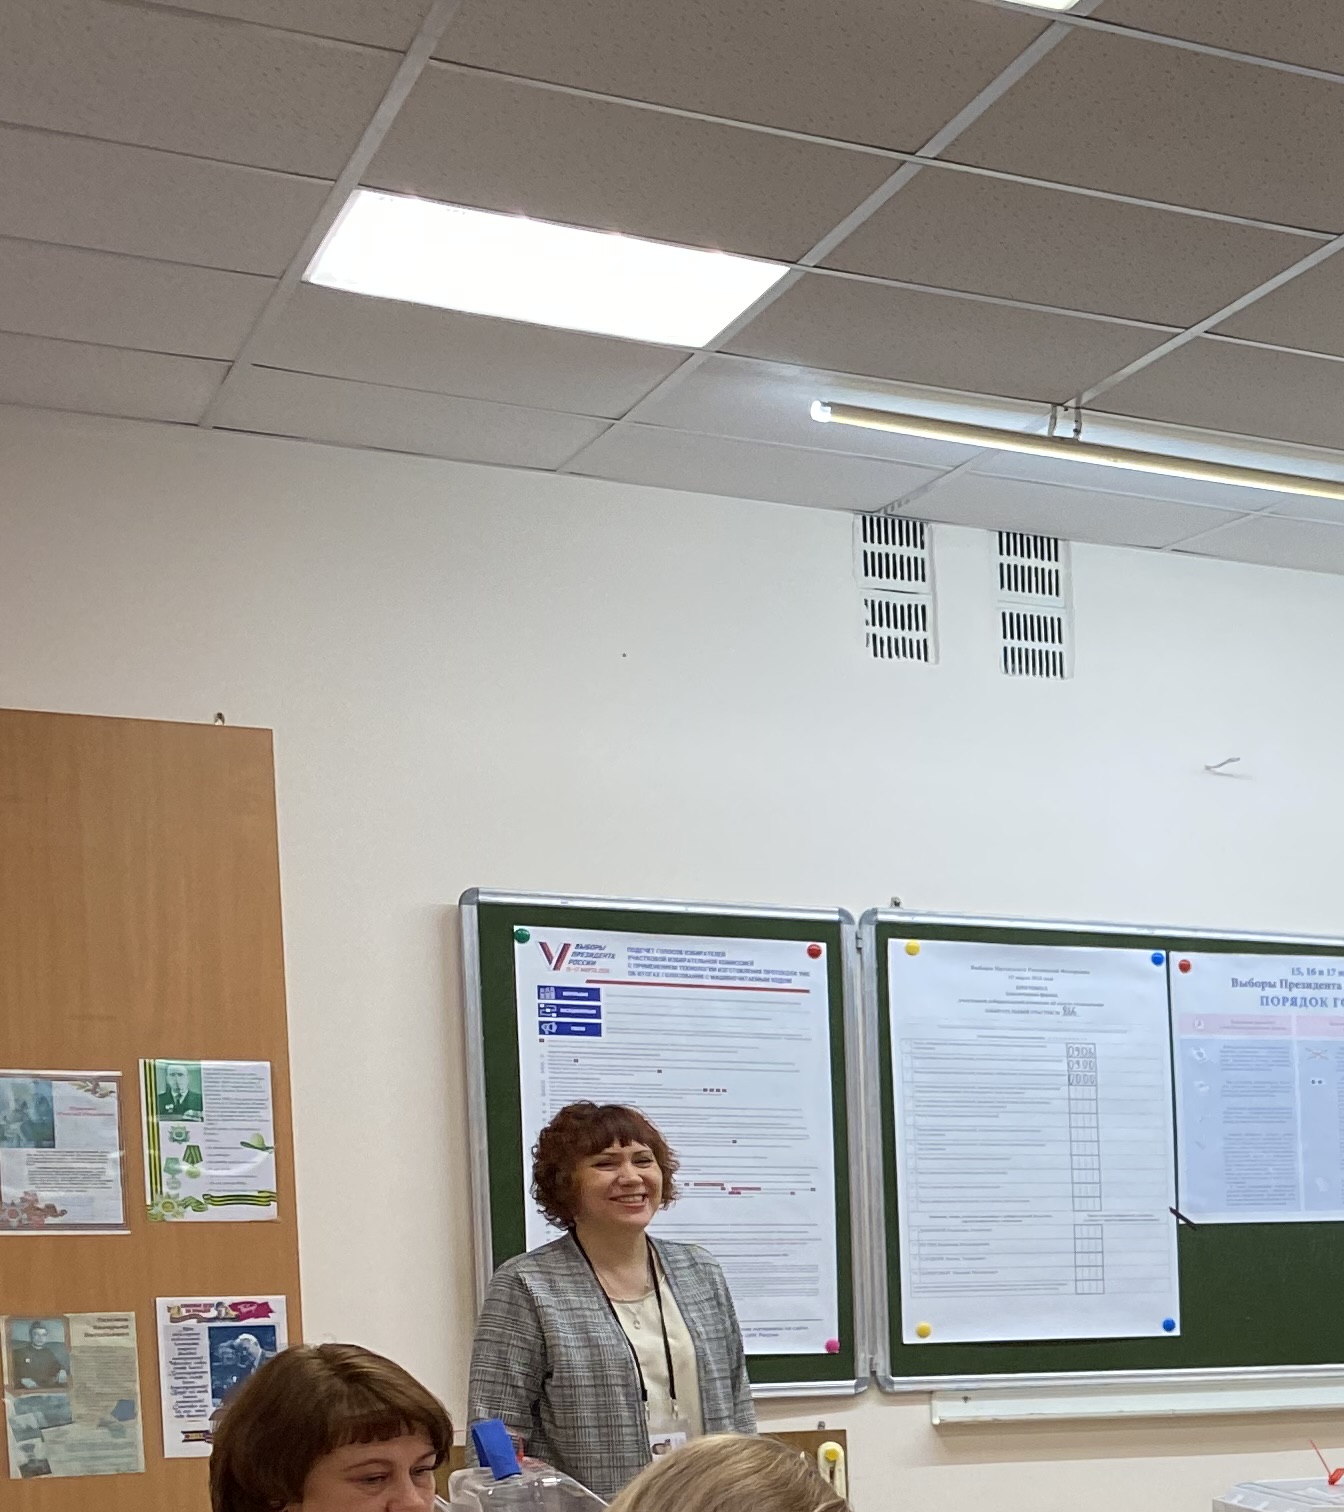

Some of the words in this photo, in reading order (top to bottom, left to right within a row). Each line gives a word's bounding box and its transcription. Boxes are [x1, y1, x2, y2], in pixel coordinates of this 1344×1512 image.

[1291, 967, 1304, 977] 15,
[1306, 967, 1317, 976] 16
[1326, 968, 1337, 977] 17
[1231, 978, 1277, 991] Выборы
[1279, 978, 1342, 992] Президента
[1260, 995, 1329, 1009] ПОРЯДОК
